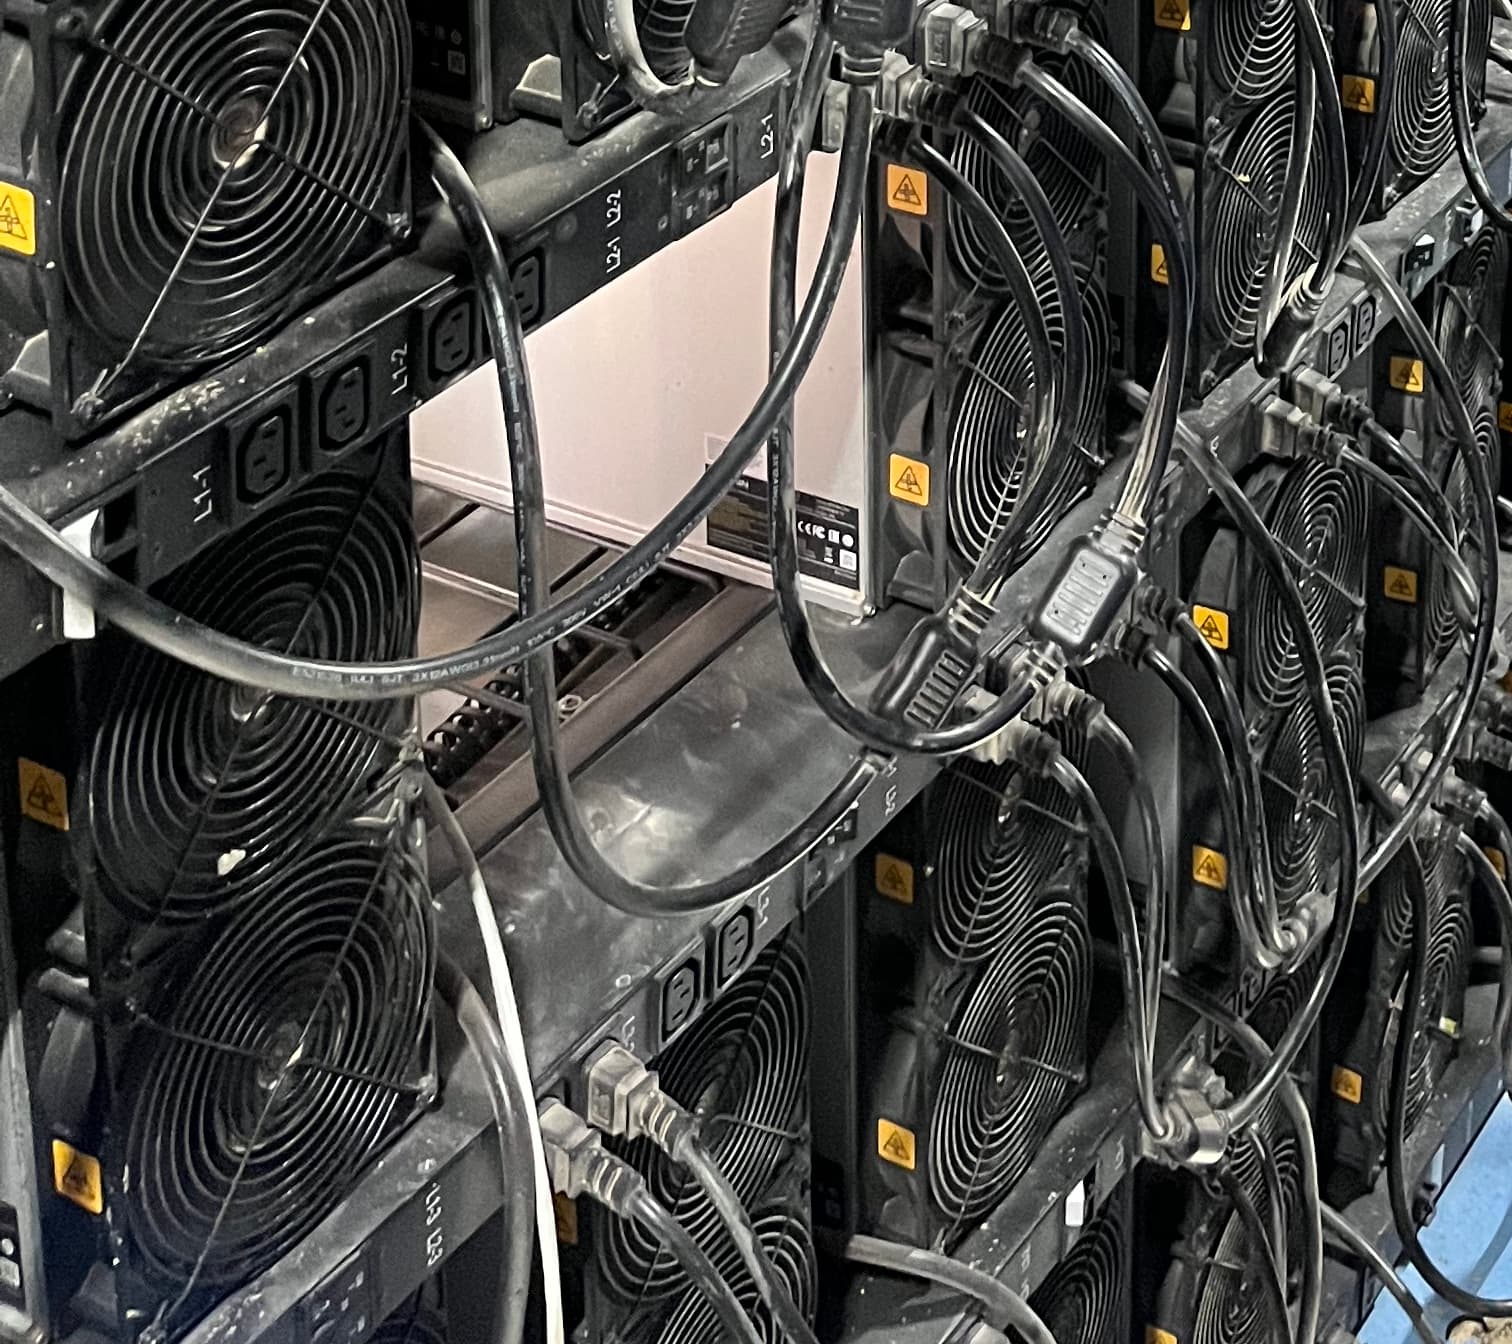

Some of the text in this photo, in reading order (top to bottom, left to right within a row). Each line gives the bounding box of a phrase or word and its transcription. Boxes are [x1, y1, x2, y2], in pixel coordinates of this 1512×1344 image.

[760, 112, 775, 160] L2-1
[606, 188, 622, 274] L2-1 L2-2
[390, 342, 408, 396] L1-2
[192, 464, 212, 523] L1-1
[426, 1226, 444, 1268] L2-3
